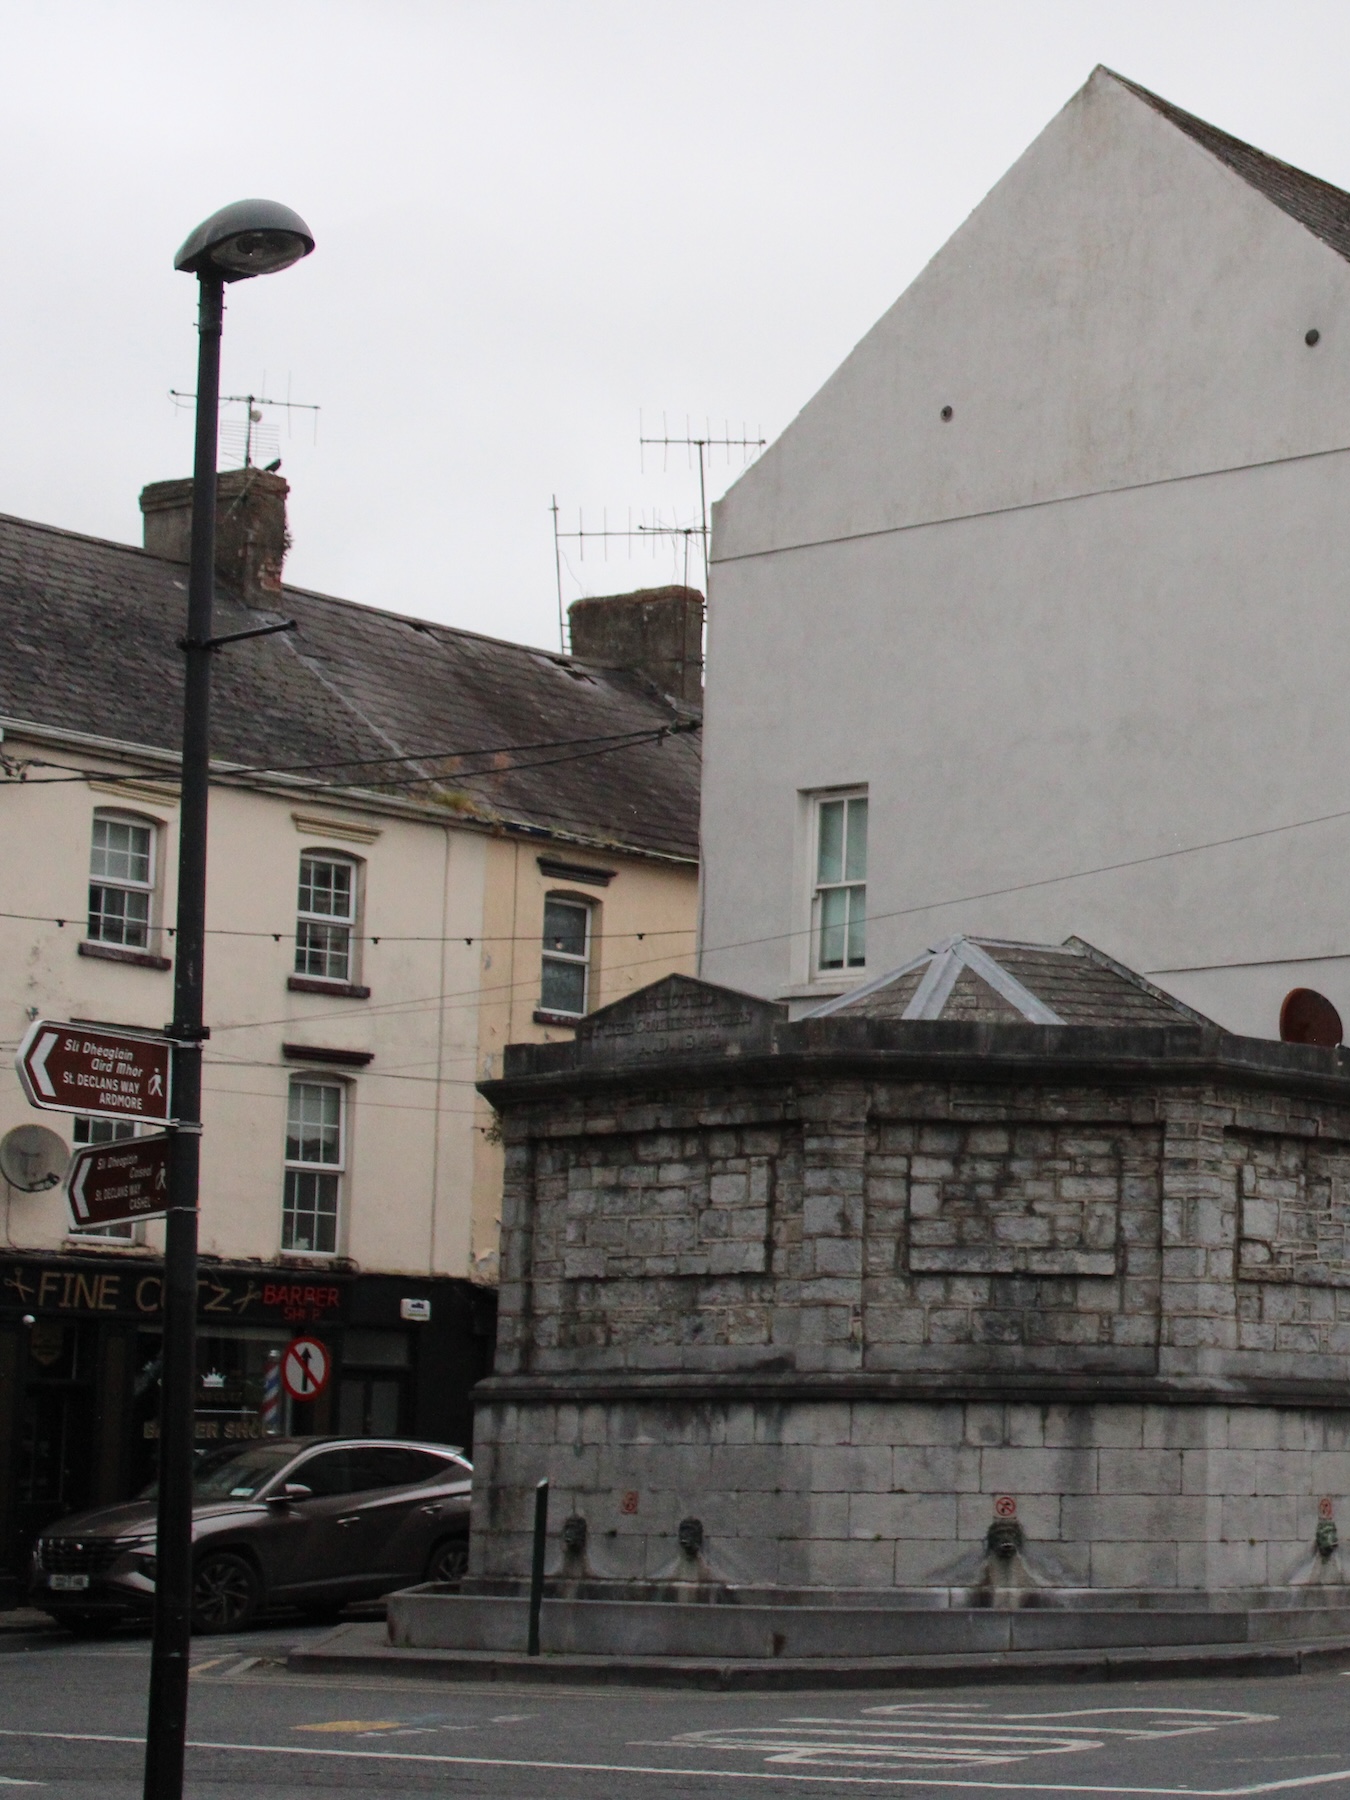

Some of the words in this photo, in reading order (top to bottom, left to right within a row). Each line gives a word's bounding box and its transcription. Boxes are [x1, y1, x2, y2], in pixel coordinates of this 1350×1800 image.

[77, 1073, 119, 1092] DECLANS
[120, 1080, 140, 1095] WAY
[99, 1092, 143, 1111] ARDMORE
[38, 1271, 121, 1310] FINE
[134, 1276, 233, 1312] CZ
[263, 1284, 340, 1307] BARBER
[283, 1306, 321, 1321] SHP
[143, 1421, 219, 1439] BER
